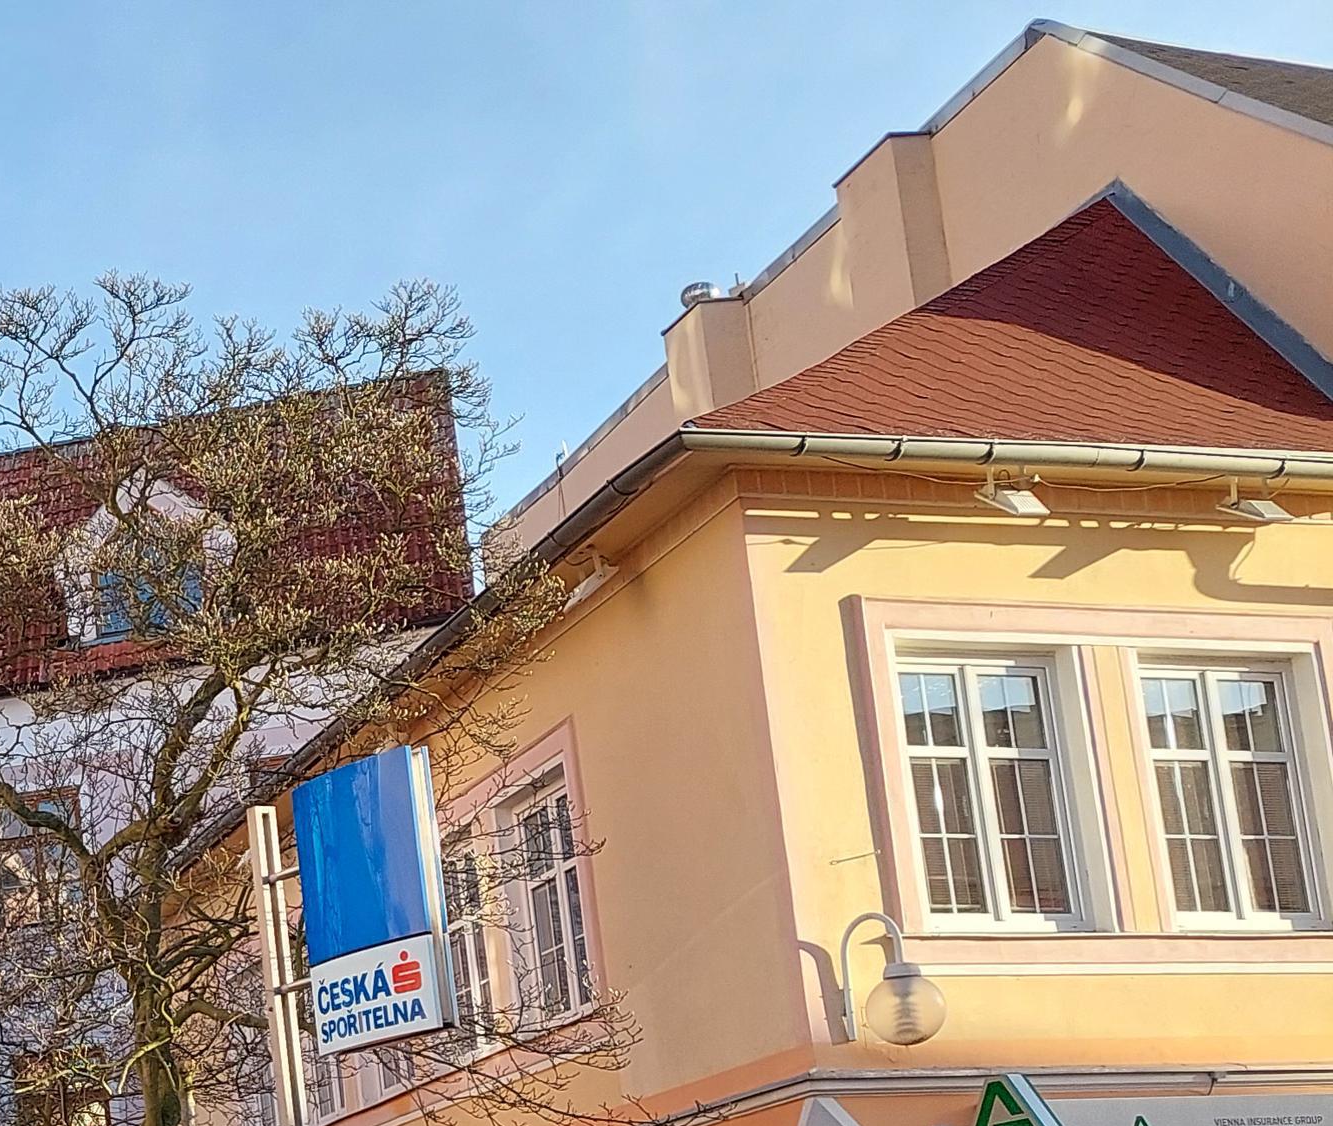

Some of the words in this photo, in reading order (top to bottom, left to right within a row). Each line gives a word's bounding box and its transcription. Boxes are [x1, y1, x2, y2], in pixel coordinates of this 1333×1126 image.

[318, 961, 392, 1015] ČESKÁ
[321, 998, 428, 1044] SPOŘITELNA
[1213, 1117, 1245, 1126] VIENNA
[1247, 1116, 1293, 1126] INSURANCE
[1295, 1115, 1323, 1125] GROUP
